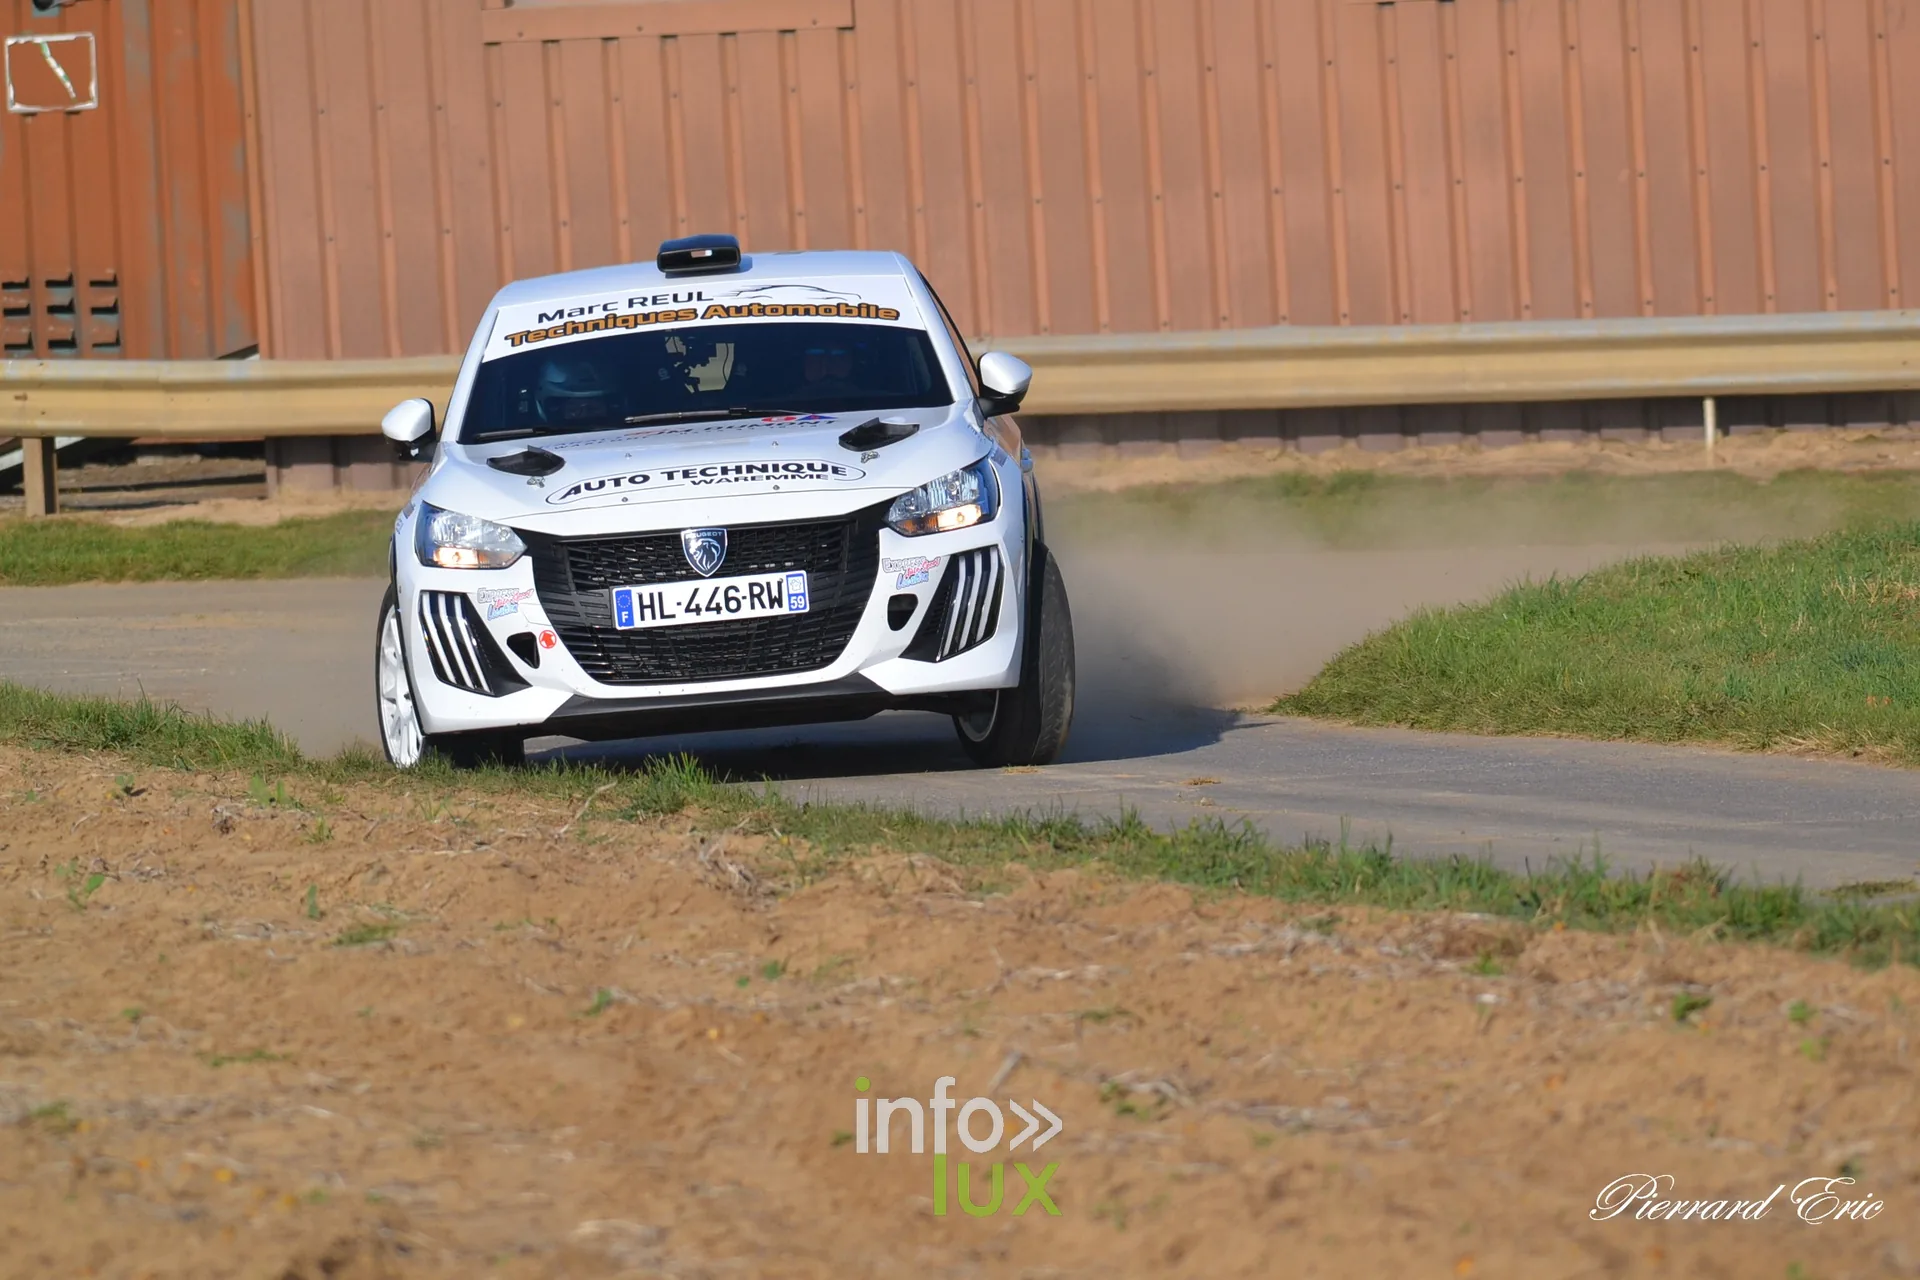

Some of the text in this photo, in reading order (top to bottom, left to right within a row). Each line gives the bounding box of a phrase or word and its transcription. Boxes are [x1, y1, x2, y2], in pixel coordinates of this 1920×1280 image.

[538, 291, 714, 324] Marc REUL
[504, 302, 901, 347] Techniques Automobile
[557, 462, 848, 501] AUTO TECHNIQUE
[690, 473, 829, 486] WAREMME
[621, 611, 629, 623] F
[638, 580, 784, 621] HL-446-RW
[790, 595, 805, 609] 59
